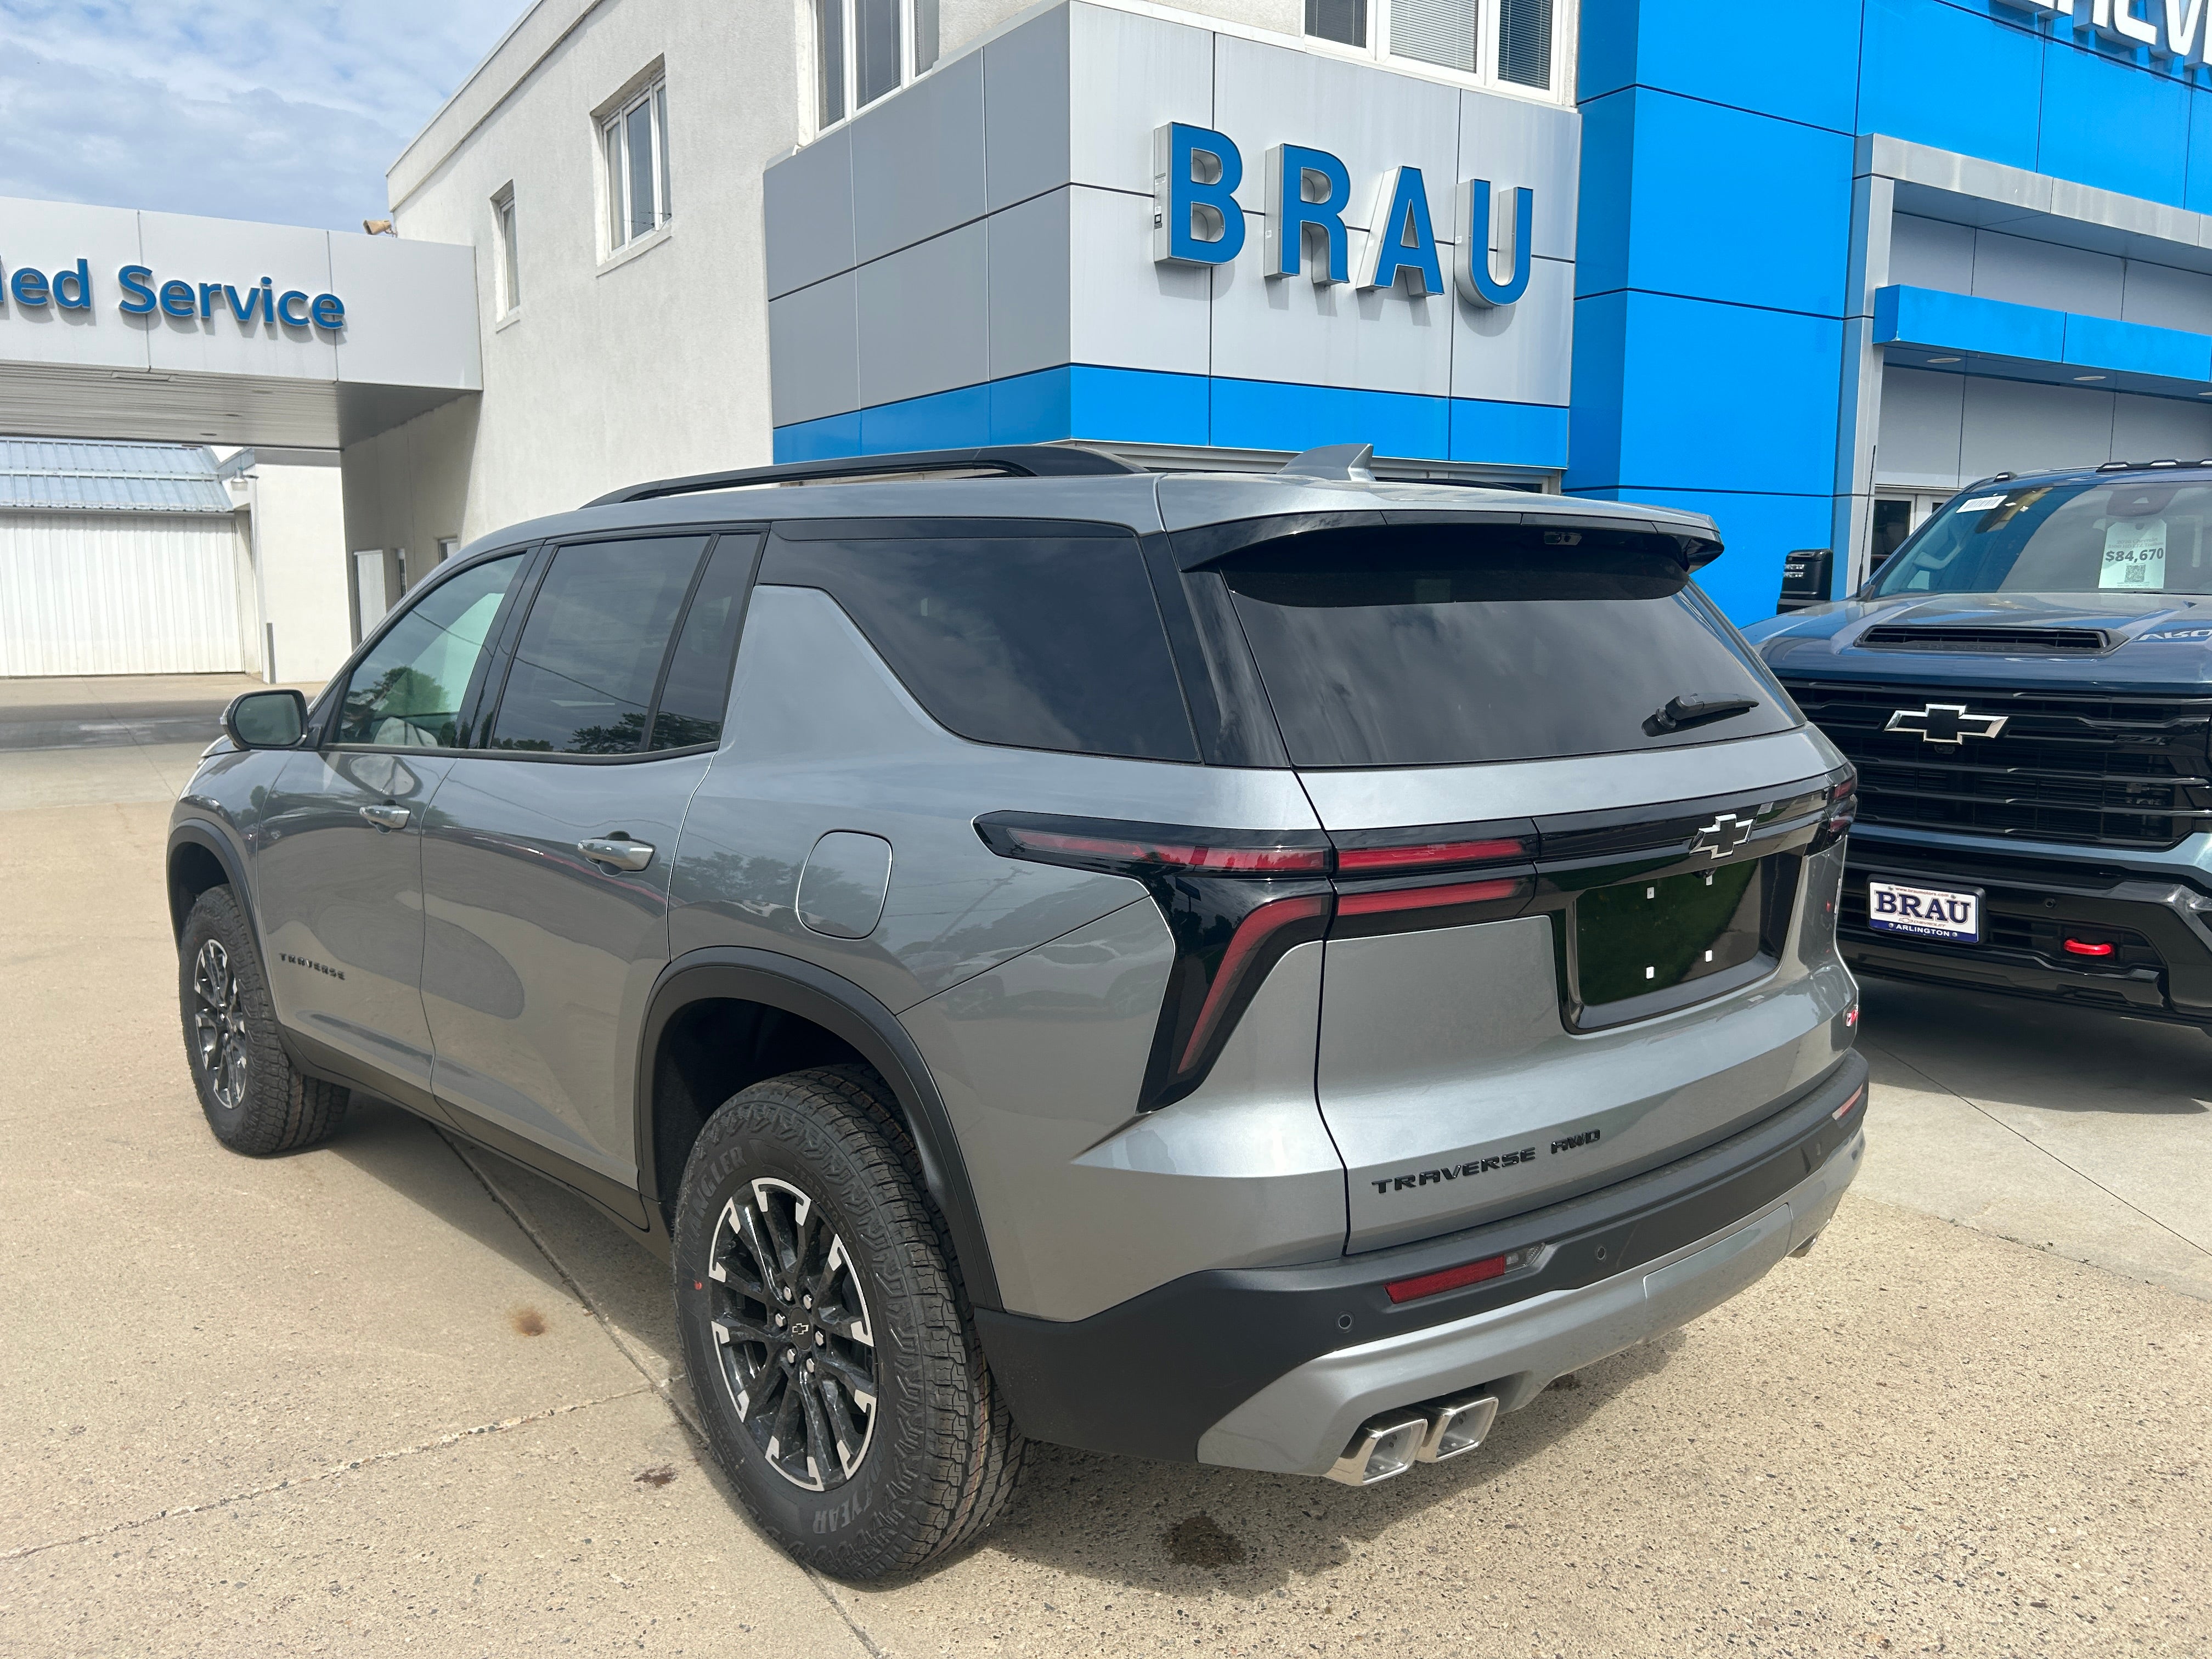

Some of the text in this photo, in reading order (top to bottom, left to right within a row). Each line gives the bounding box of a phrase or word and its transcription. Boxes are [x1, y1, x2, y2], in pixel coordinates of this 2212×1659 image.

[1154, 121, 1534, 308] BRAU
[0, 256, 345, 329] ed Service
[2105, 548, 2164, 563] $84,670
[1874, 890, 1971, 924] BRAU
[1895, 887, 1949, 898] www.braumotors.com
[1895, 924, 1950, 937] ARLINGTON
[279, 952, 346, 980] TRAVERSE
[1371, 1128, 1601, 1194] TRAVERSE AWD
